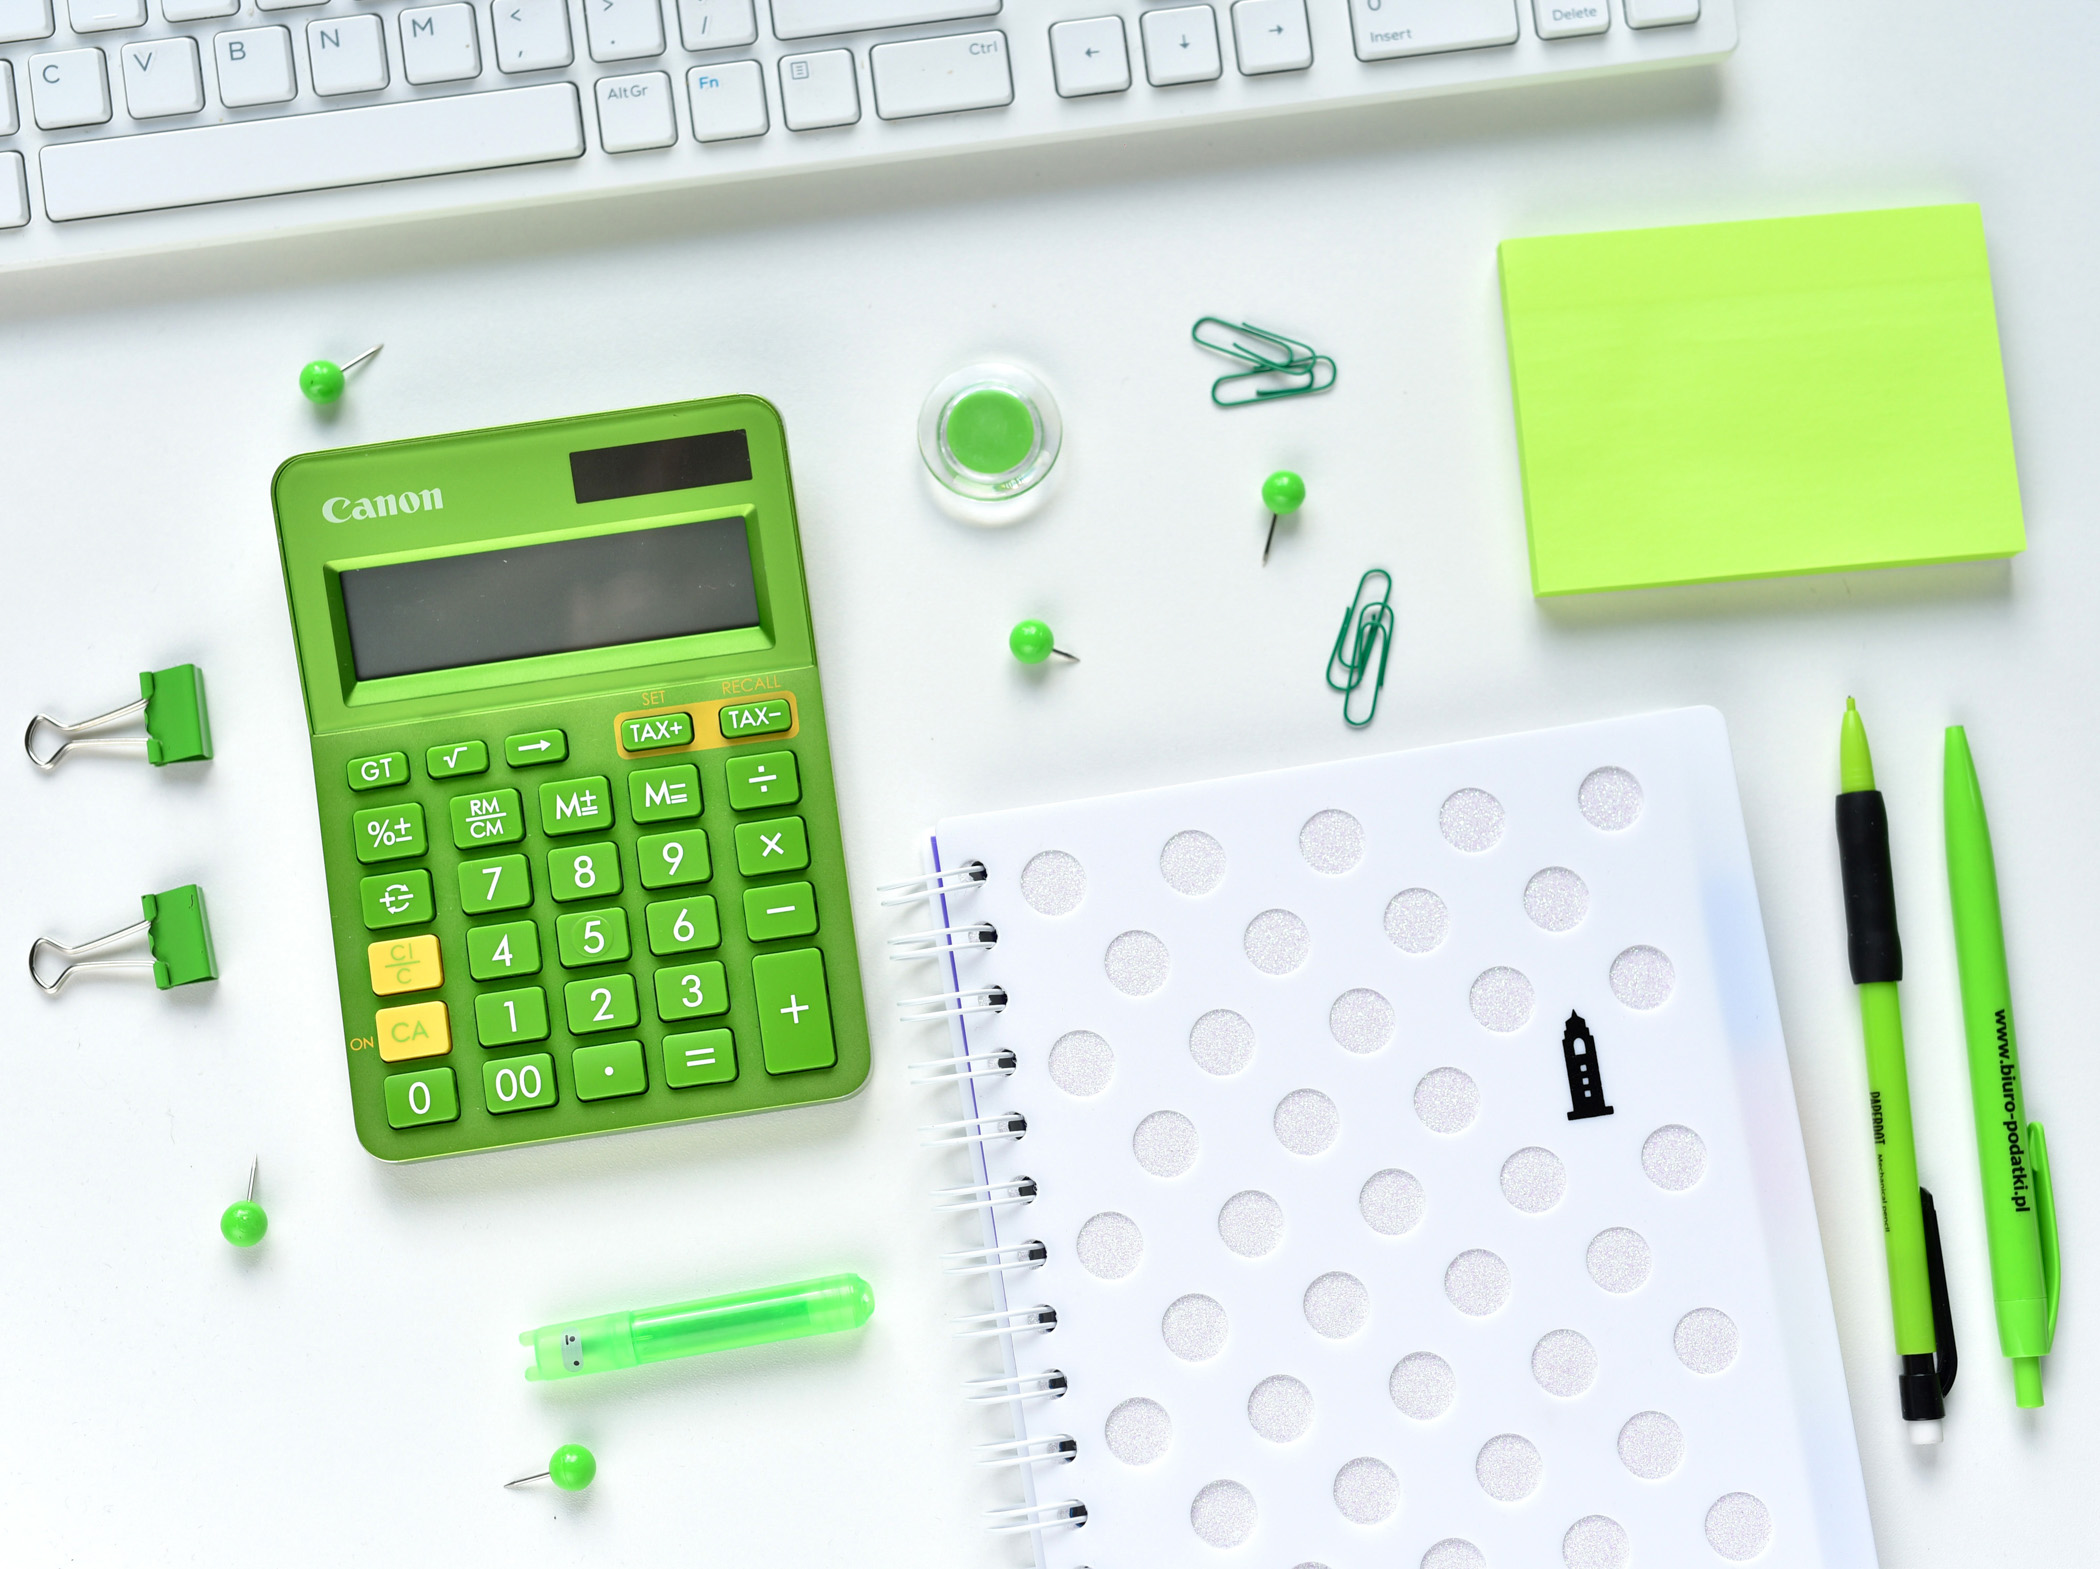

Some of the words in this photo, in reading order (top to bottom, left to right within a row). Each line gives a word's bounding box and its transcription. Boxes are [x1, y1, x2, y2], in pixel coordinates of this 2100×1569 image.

[1552, 7, 1597, 21] Delete
[411, 16, 435, 38] M
[1370, 28, 1412, 43] Insert
[319, 28, 341, 50] N
[968, 40, 998, 56] Ctrl
[133, 52, 153, 73] V
[228, 41, 247, 62] B
[41, 64, 61, 84] C
[699, 76, 719, 90] Fn
[322, 488, 444, 524] Canon
[722, 674, 781, 694] RECALL
[642, 690, 666, 706] SET
[629, 720, 683, 743] TAX+
[360, 757, 393, 781] GT
[470, 796, 501, 817] RM
[470, 818, 504, 839] CM
[662, 841, 684, 876] 9
[482, 866, 503, 901] 7
[573, 855, 596, 889] 8
[673, 908, 695, 942] 6
[583, 920, 605, 954] 5
[491, 933, 513, 967] 4
[396, 968, 412, 985] C
[681, 974, 704, 1008] 3
[590, 987, 615, 1022] 2
[503, 1000, 518, 1033] 1
[391, 1020, 429, 1043] CA
[350, 1036, 374, 1051] ON
[495, 1064, 542, 1102] 00
[408, 1081, 431, 1115] 0
[1995, 1009, 2030, 1212] www.biuro-podatki.pl
[1878, 1153, 1888, 1204] Mechanical
[1882, 1206, 1890, 1233] pencil
